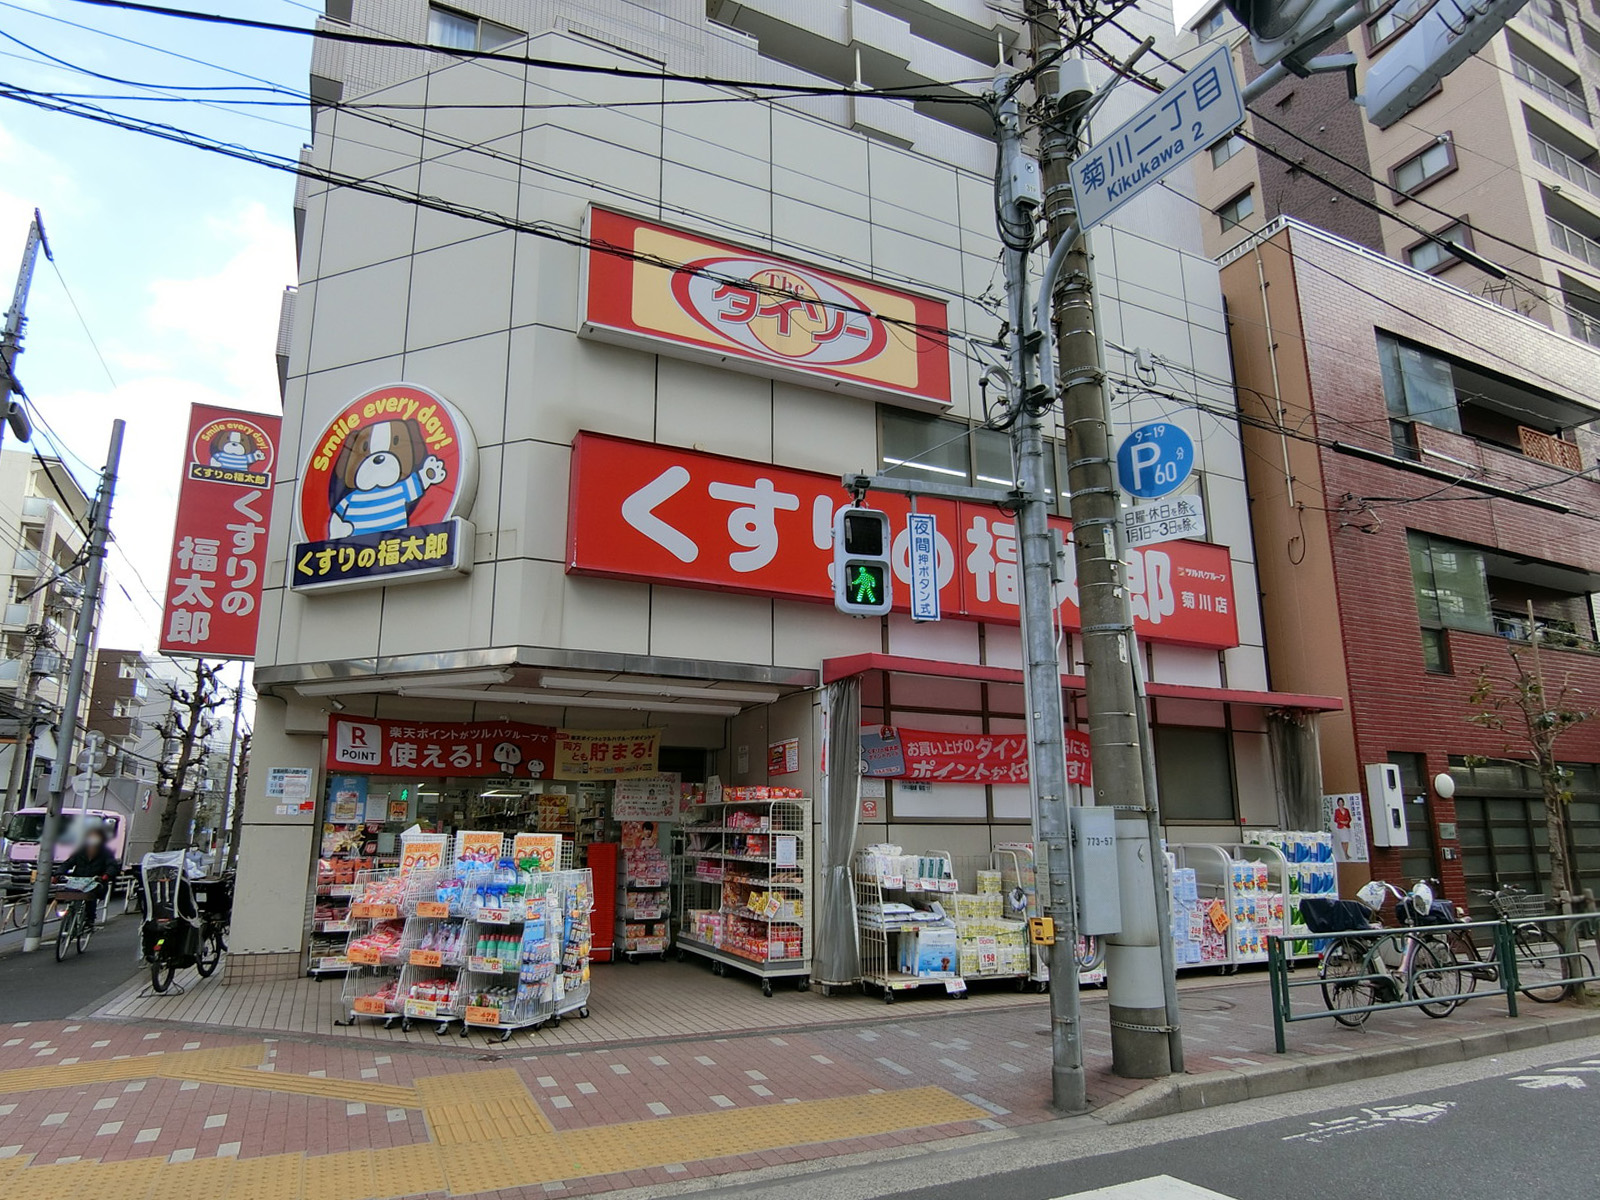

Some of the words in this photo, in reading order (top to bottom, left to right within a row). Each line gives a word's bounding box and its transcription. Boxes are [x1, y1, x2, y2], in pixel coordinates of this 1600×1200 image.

[1080, 66, 1222, 195] 菊川二丁目
[1107, 138, 1185, 202] Kikukawa
[1191, 121, 1204, 142] 2
[765, 272, 805, 296] The
[201, 424, 225, 441] Smile
[227, 423, 254, 435] every
[313, 413, 361, 472] Smile
[363, 397, 420, 421] every
[417, 404, 453, 450] day!
[1135, 425, 1165, 442] 9-19
[193, 467, 266, 485] くすりの福太郎
[1130, 442, 1161, 491] P
[1155, 461, 1177, 485] 60
[221, 490, 266, 617] くすりの
[297, 532, 449, 577] くすりの福太郎
[621, 465, 1175, 624] くすの福郎
[914, 519, 931, 614] 夜間押ボタン式
[1185, 568, 1226, 582] ツルハグループ
[166, 536, 221, 645] 福太郎
[1181, 591, 1228, 614] 菊川店
[351, 726, 368, 747] R
[389, 726, 549, 743] 楽天ポイントがツルハグループで
[341, 749, 377, 761] POINT
[389, 741, 483, 769] 使える!
[1086, 837, 1114, 847] 773-57
[491, 912, 502, 921] 50
[983, 953, 995, 962] 158
